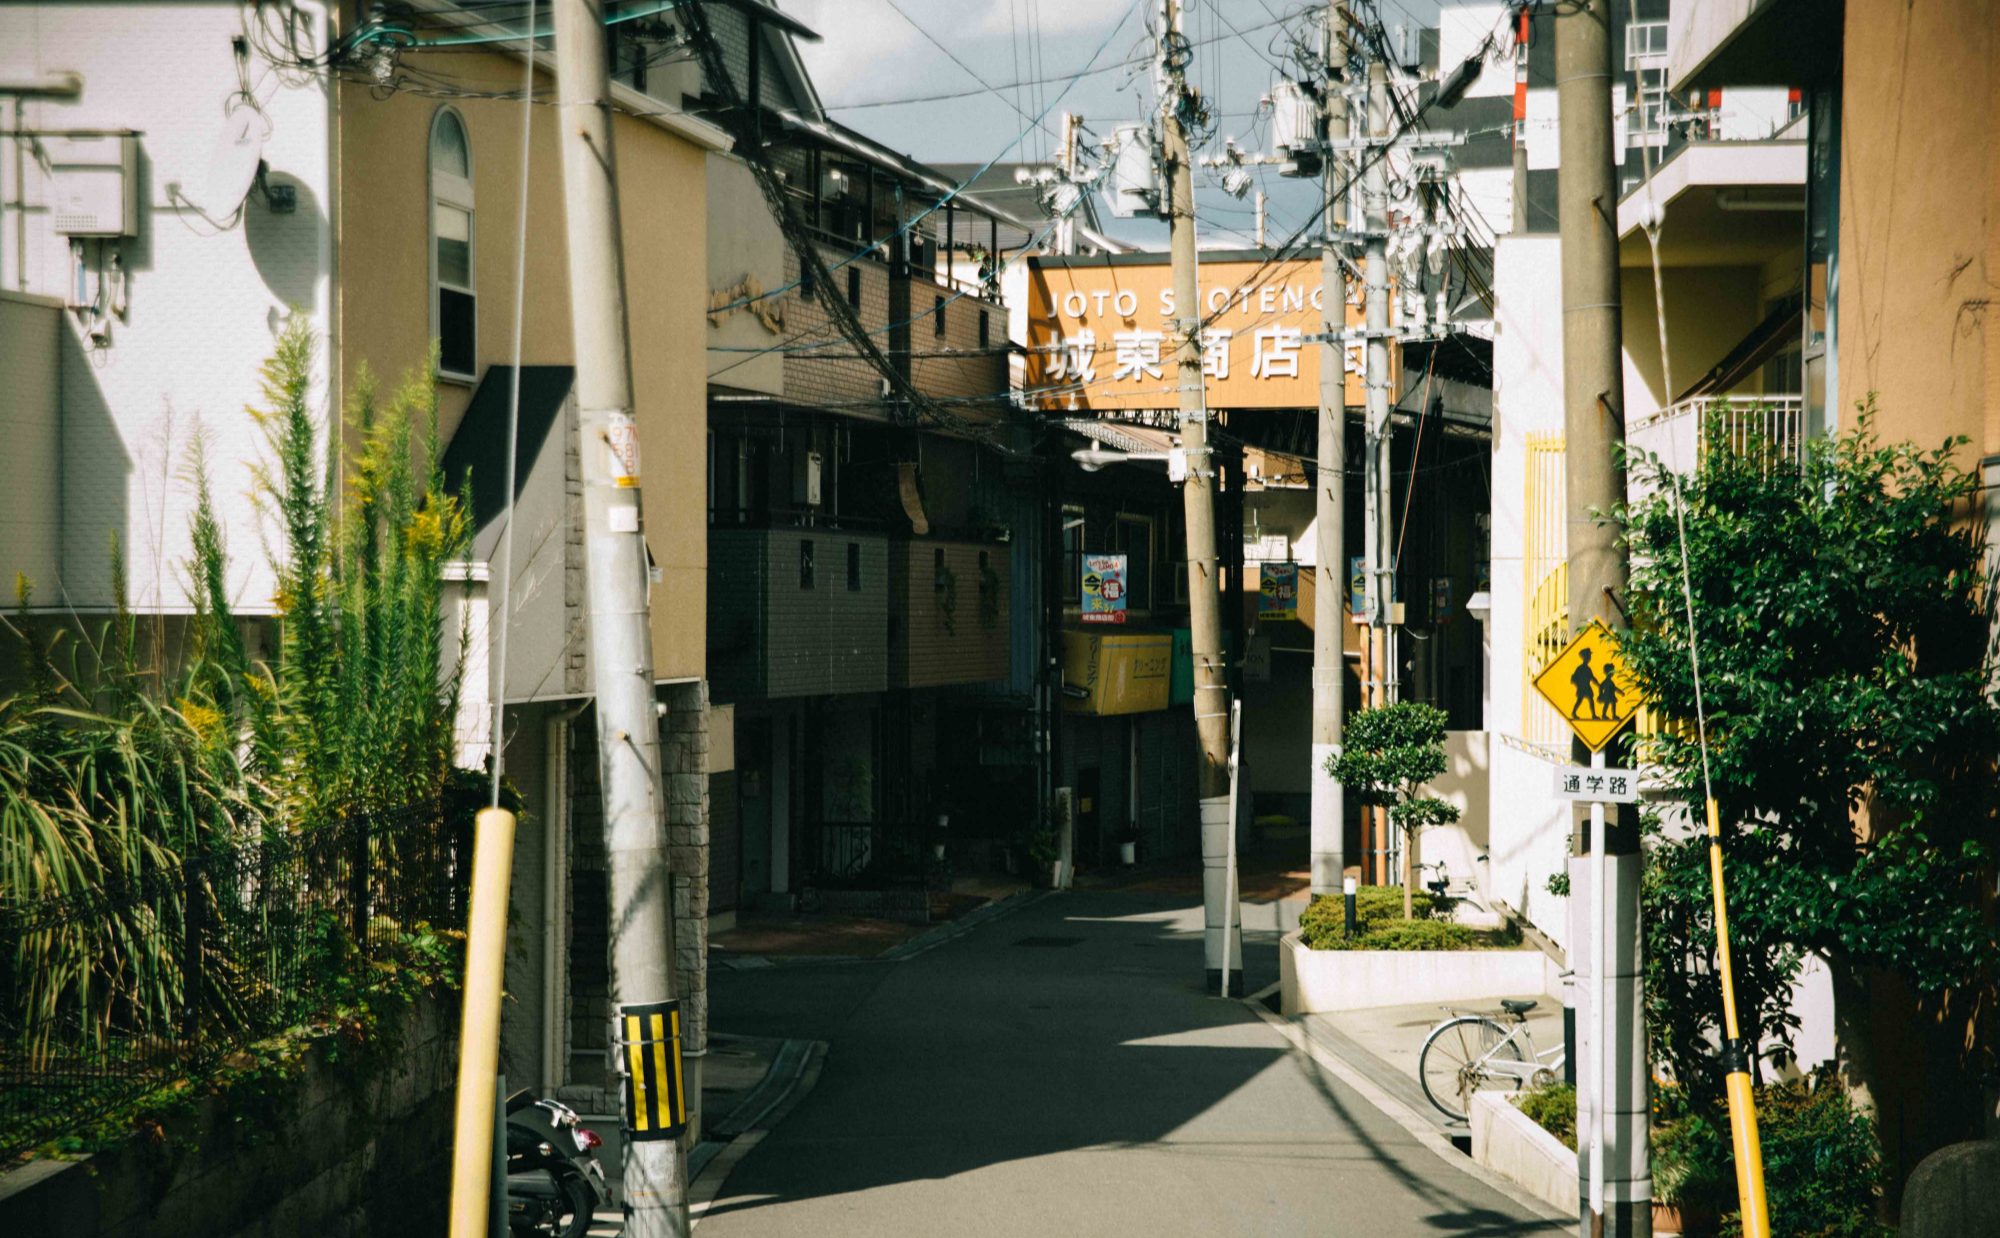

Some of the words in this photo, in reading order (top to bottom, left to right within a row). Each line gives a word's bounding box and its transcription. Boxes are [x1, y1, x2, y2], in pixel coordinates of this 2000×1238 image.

[1047, 290, 1137, 318] JOTO
[1564, 774, 1627, 795] 通学路
